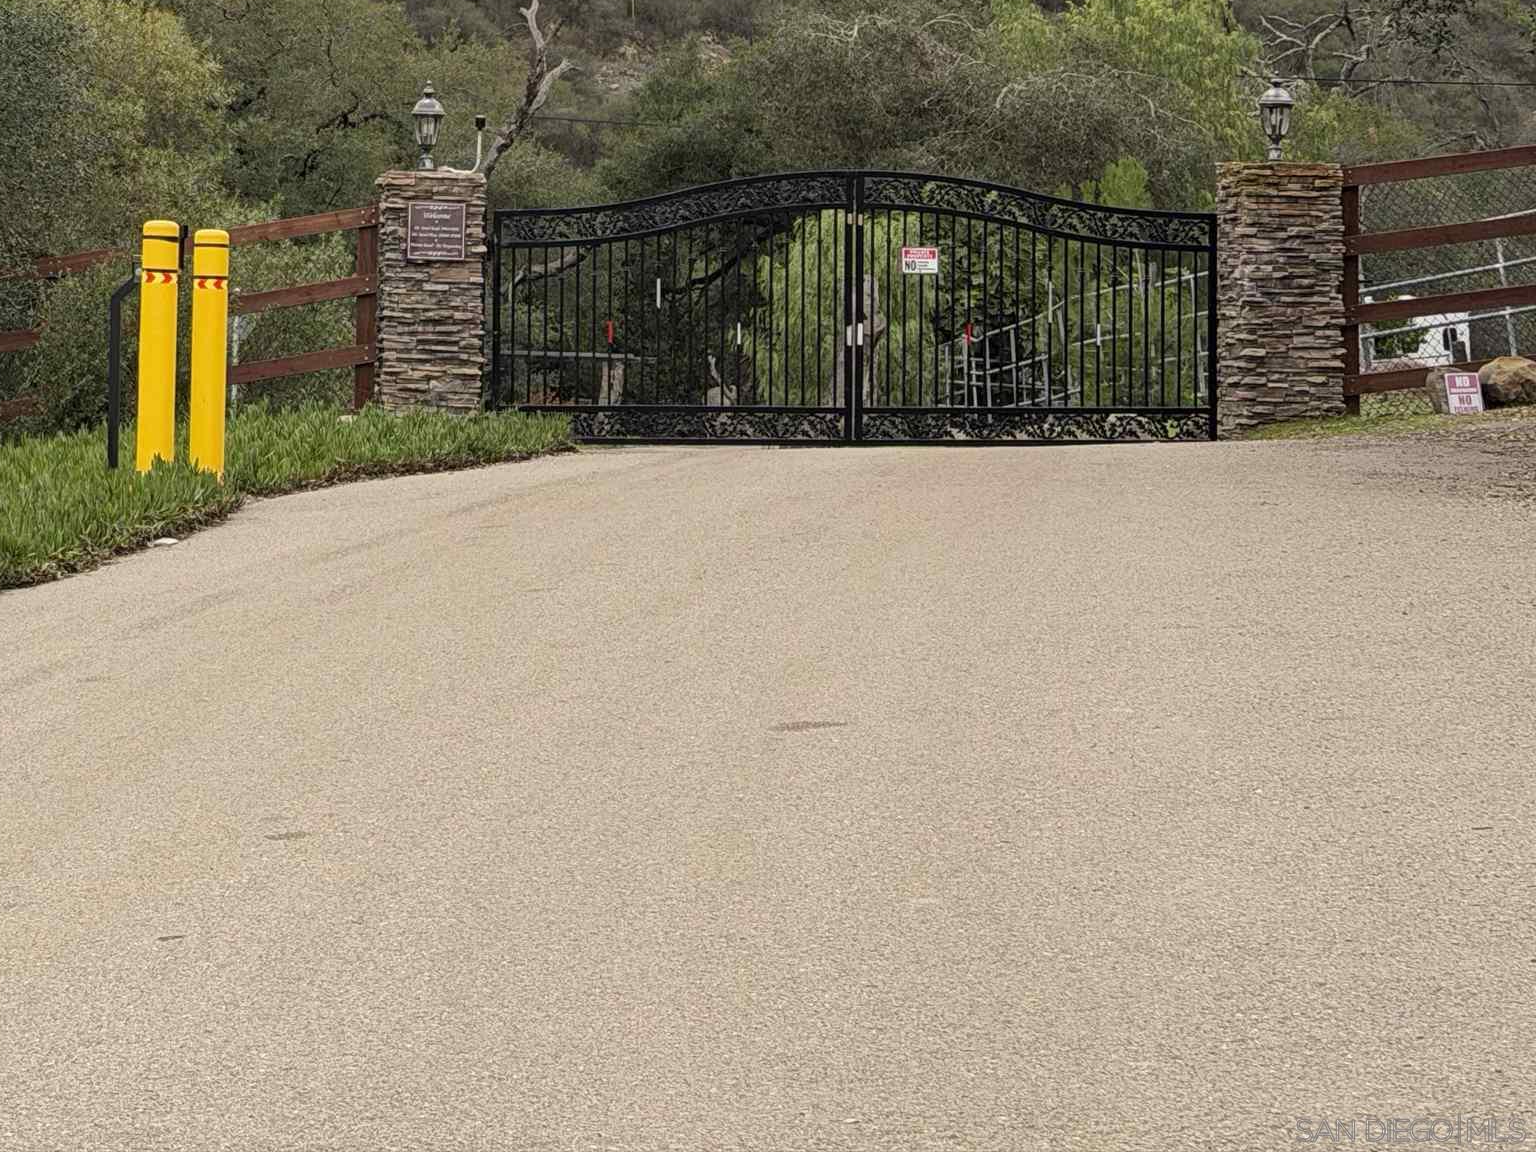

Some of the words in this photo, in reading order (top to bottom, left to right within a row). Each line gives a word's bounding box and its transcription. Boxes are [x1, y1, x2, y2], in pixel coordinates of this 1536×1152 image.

[905, 259, 917, 271] NO
[1455, 375, 1470, 387] NO
[1457, 394, 1472, 405] NO
